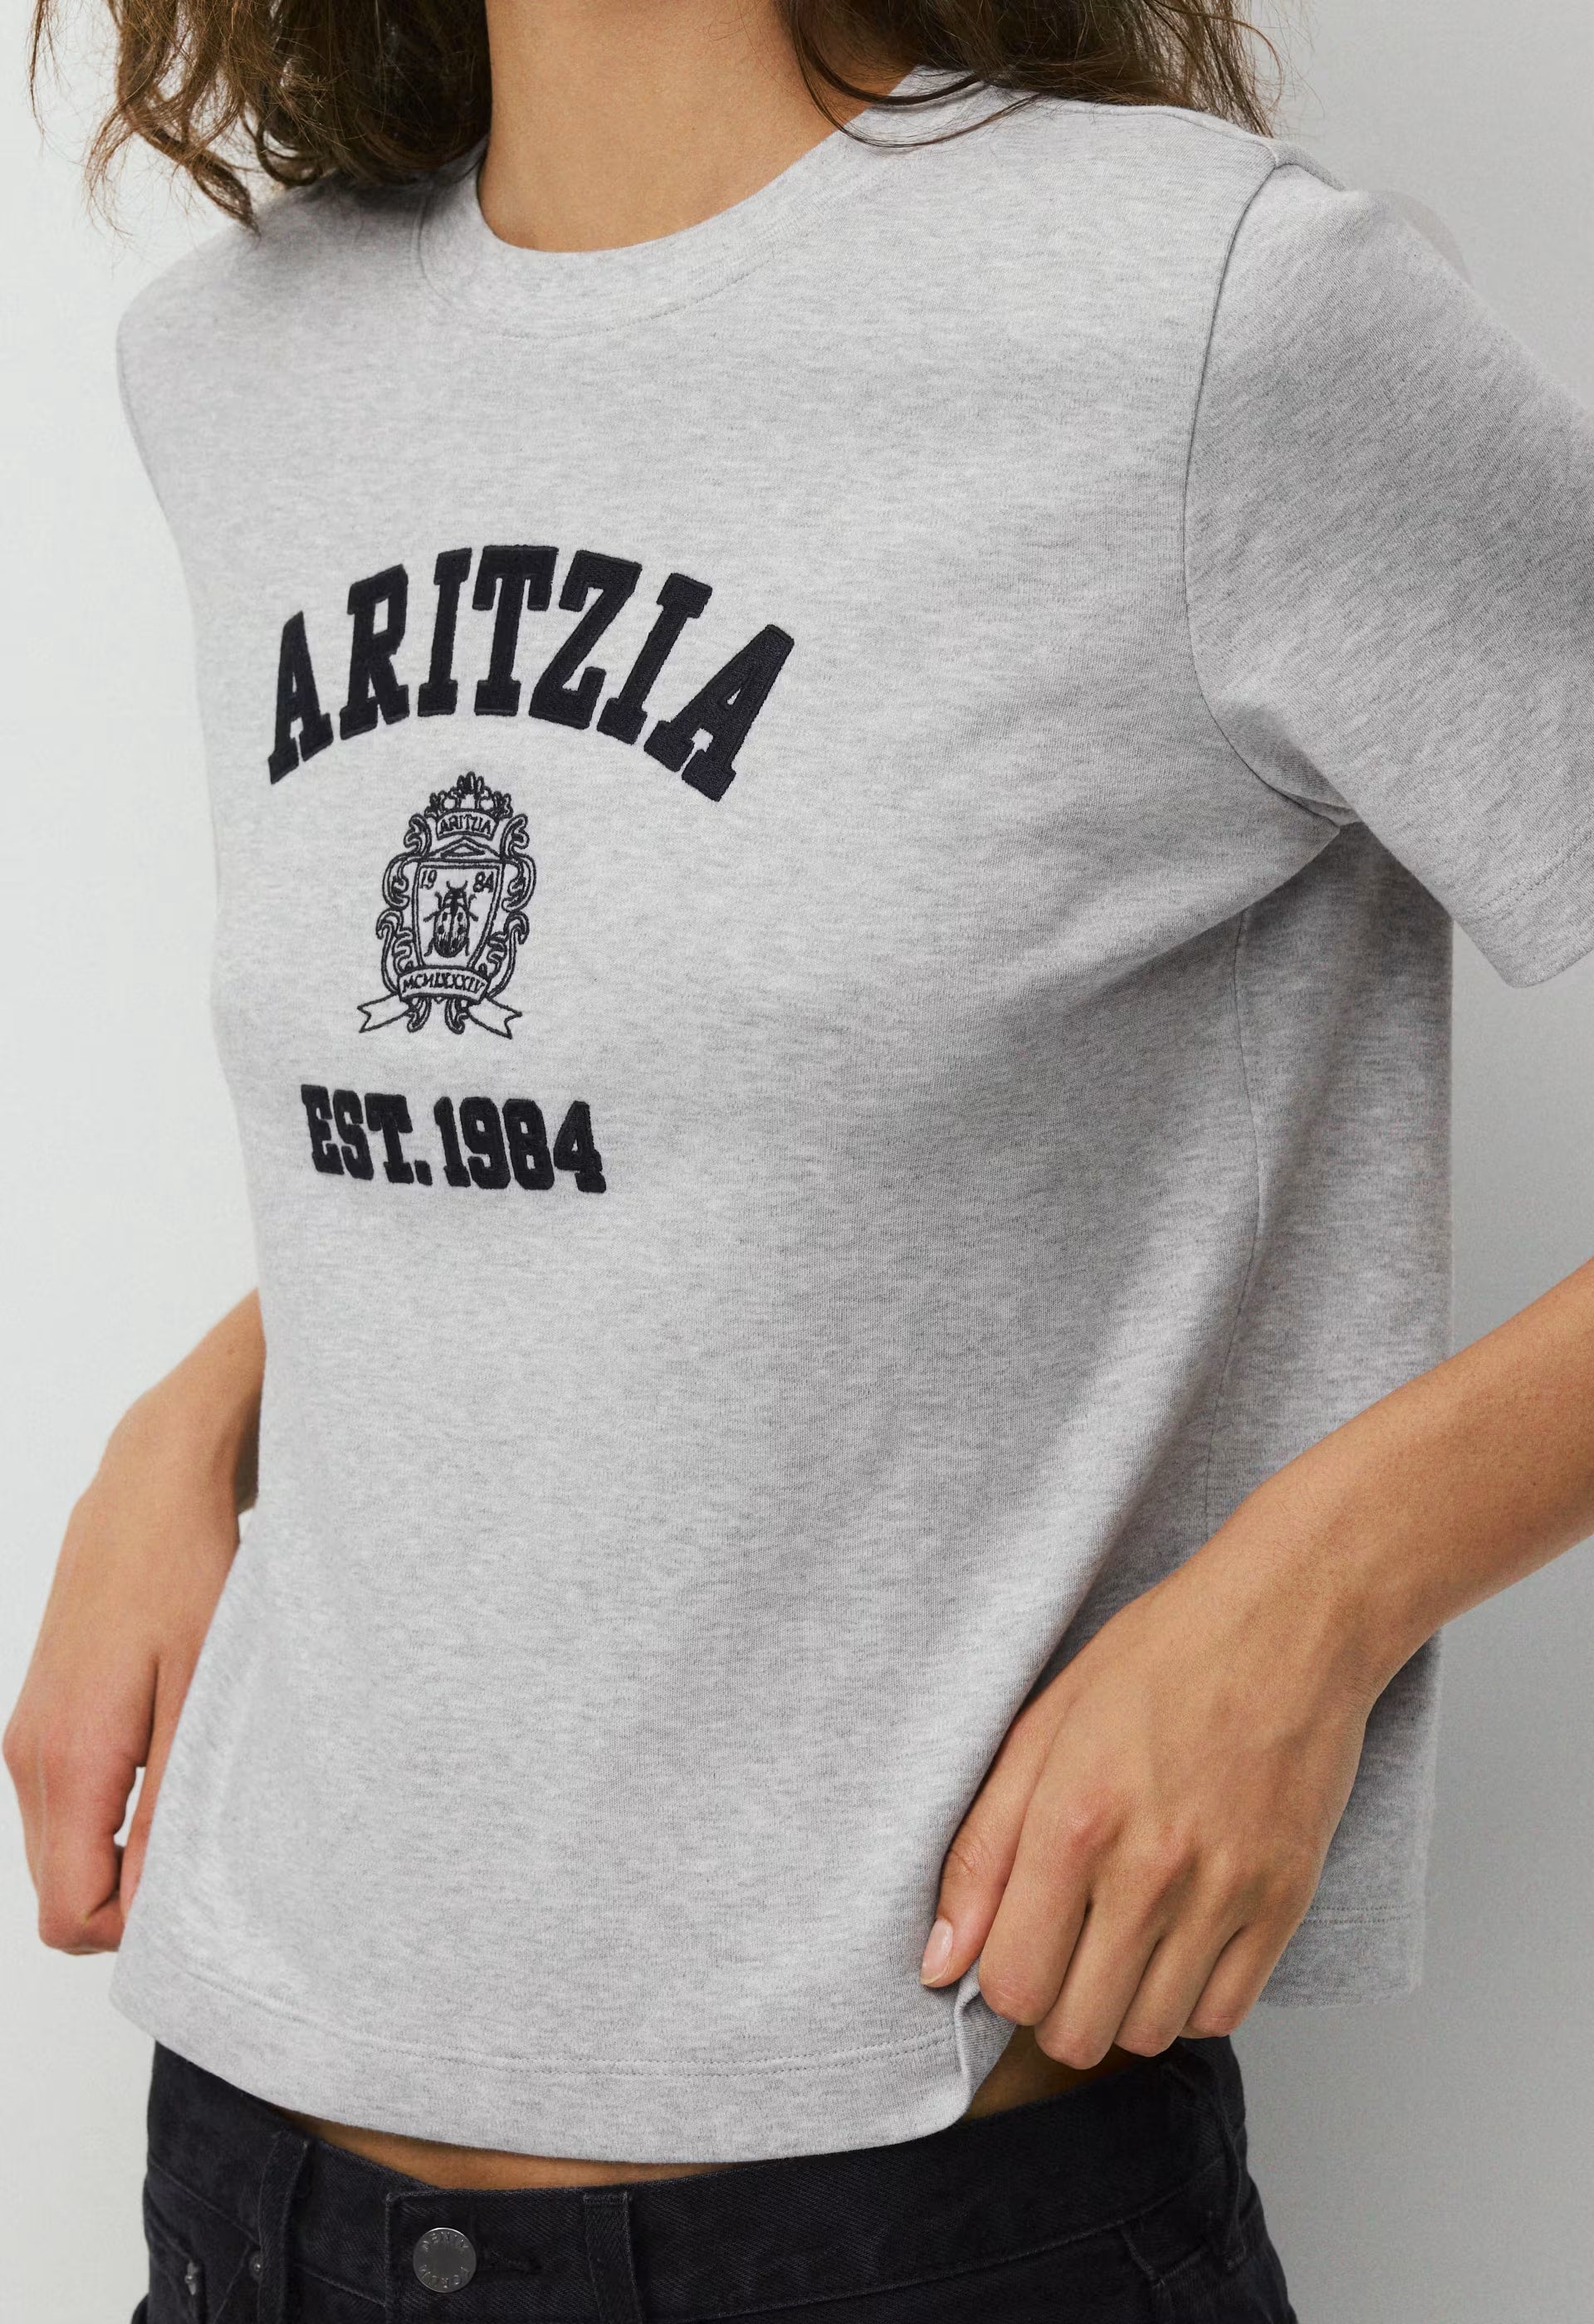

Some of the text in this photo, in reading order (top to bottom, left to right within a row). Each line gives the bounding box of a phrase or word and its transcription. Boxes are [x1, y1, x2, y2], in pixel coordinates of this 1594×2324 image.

[267, 544, 795, 802] ARITZIA
[438, 813, 491, 835] ARITZIA
[419, 868, 495, 894] 19 84
